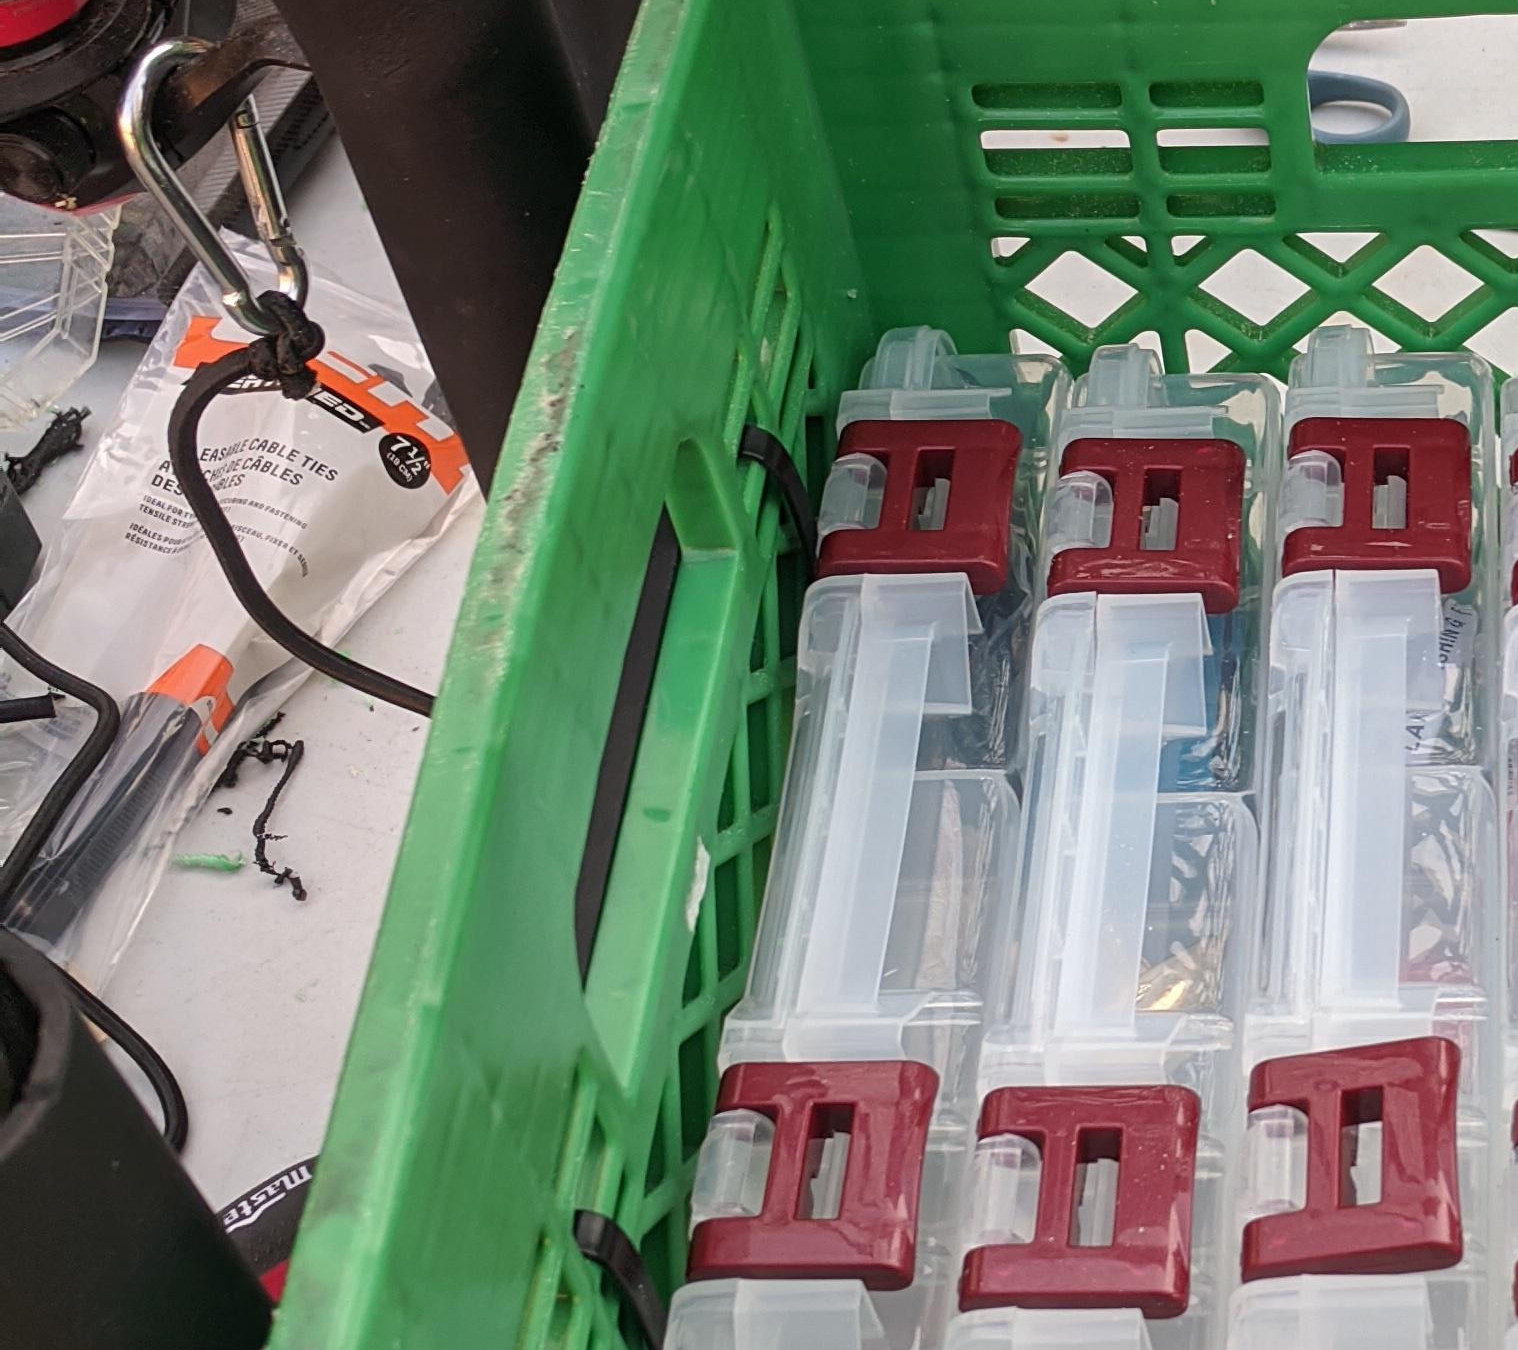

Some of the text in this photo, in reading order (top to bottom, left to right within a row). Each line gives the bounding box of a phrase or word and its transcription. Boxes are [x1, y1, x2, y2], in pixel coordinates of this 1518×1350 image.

[241, 455, 304, 486] CÂBLES
[248, 438, 301, 463] CABLE
[300, 455, 339, 482] TIES
[139, 503, 171, 524] TENSILE
[143, 494, 166, 511] IDEAL
[165, 503, 184, 516] FOR
[264, 505, 308, 530] FASTENING
